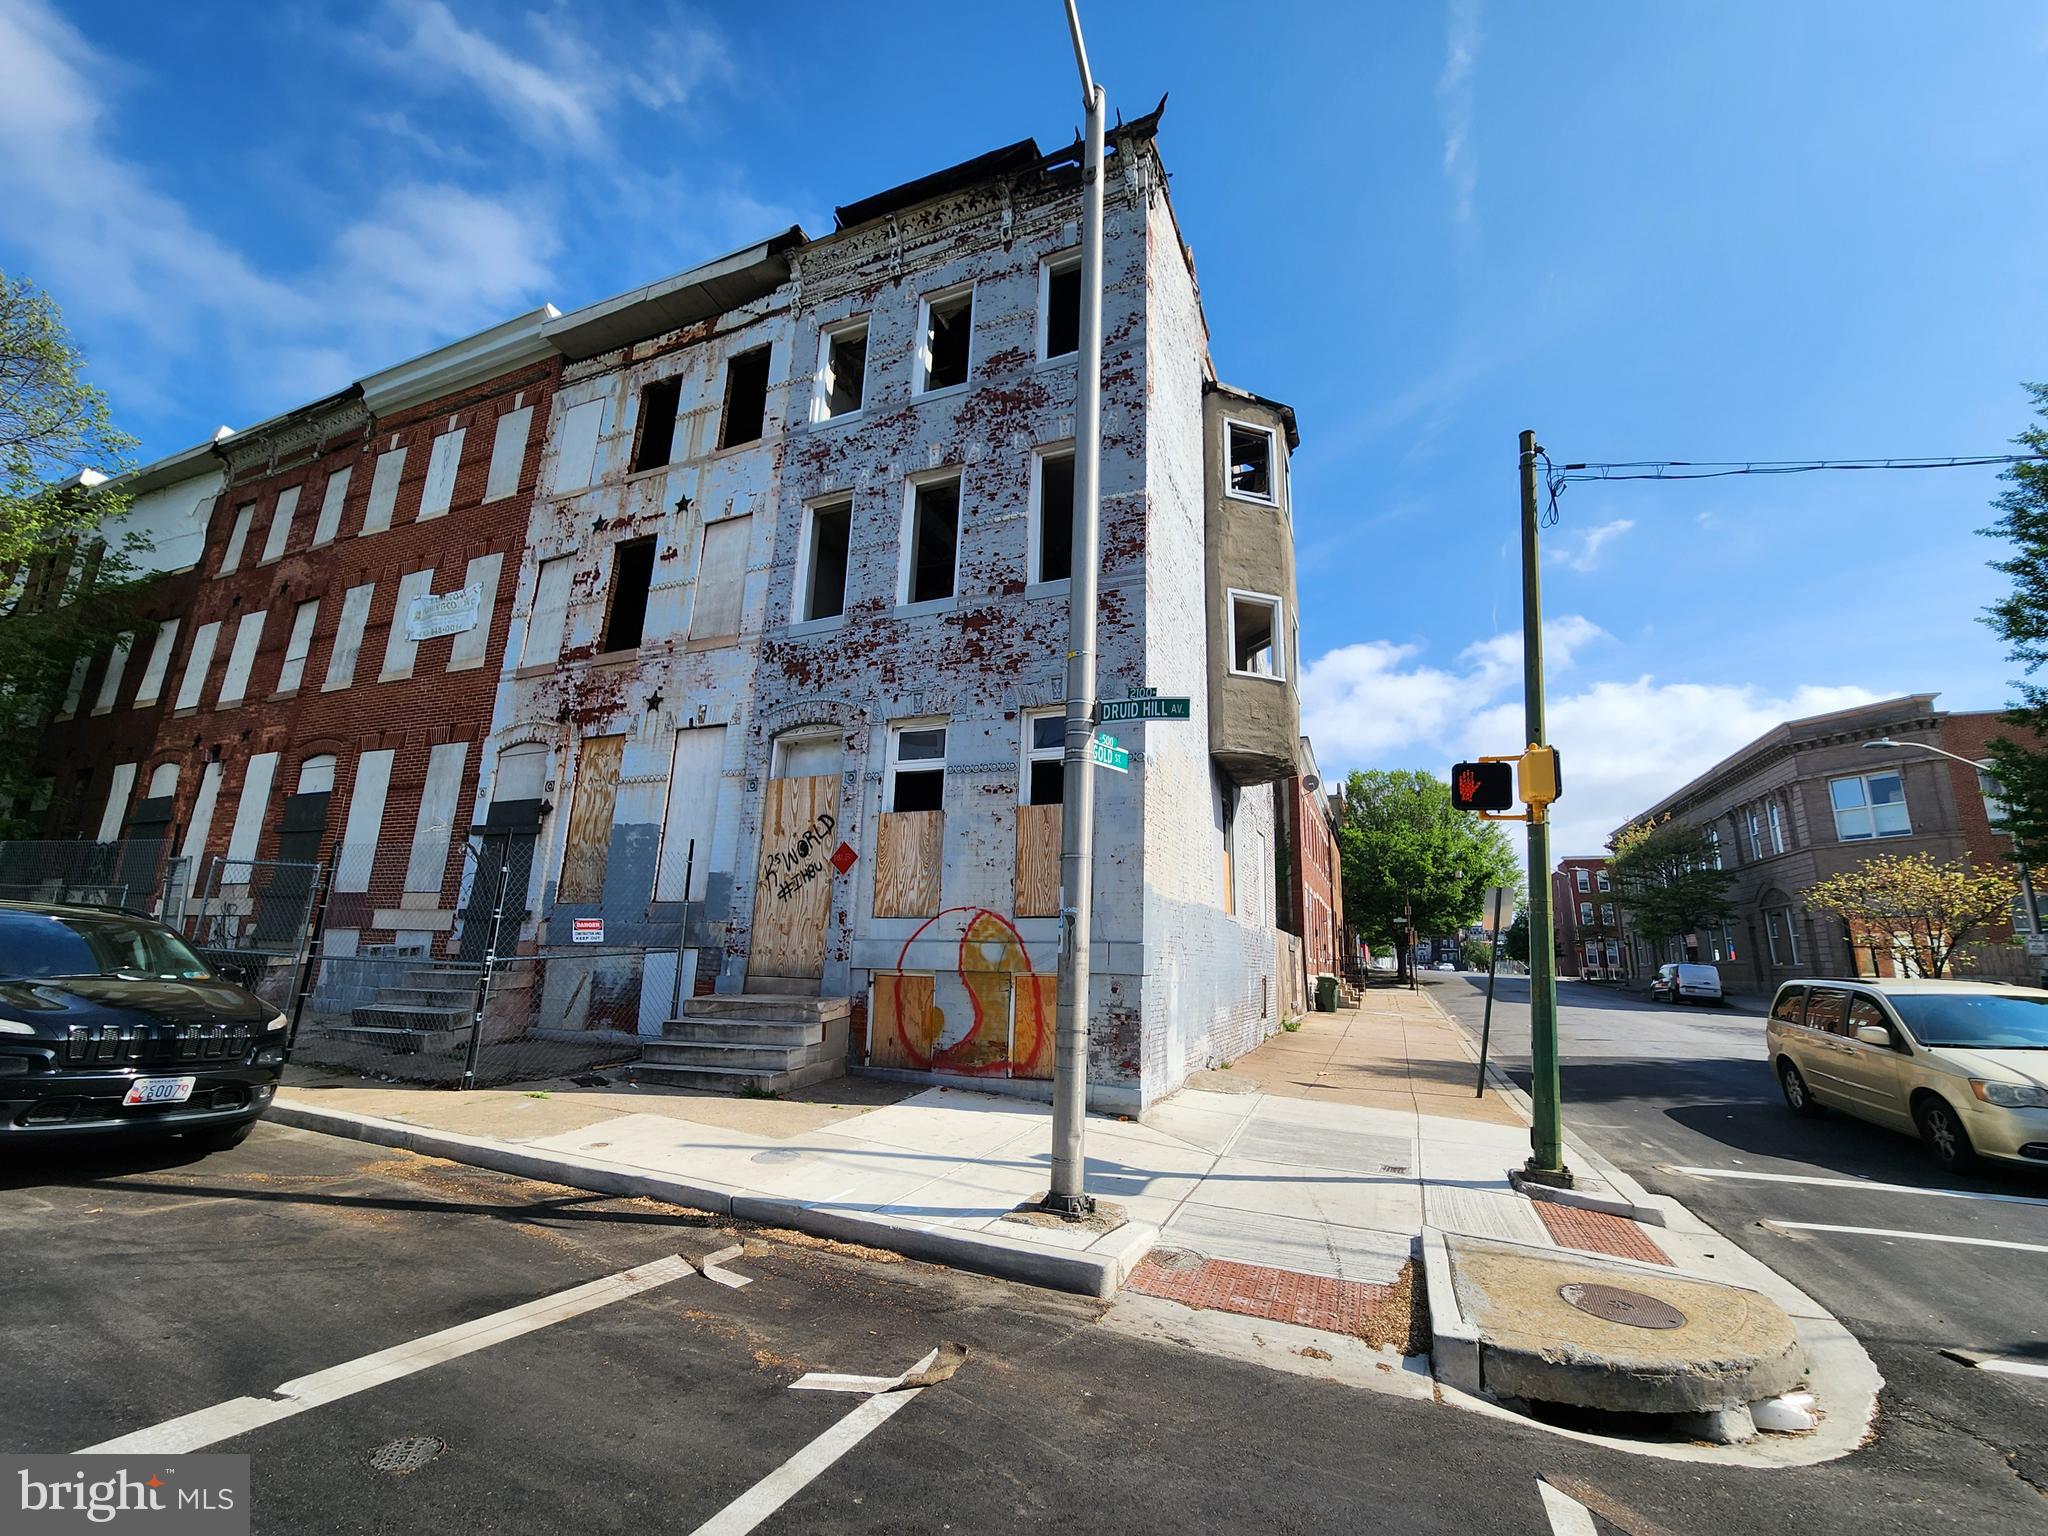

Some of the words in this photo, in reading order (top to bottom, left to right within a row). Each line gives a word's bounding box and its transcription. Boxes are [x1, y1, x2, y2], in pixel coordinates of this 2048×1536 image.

[1129, 688, 1153, 698] 2100
[1103, 702, 1139, 720] DRUID
[1143, 700, 1168, 717] HILL
[1170, 703, 1185, 714] AV.
[1102, 734, 1114, 746] 500
[1093, 745, 1113, 763] GOLD
[782, 814, 836, 872] WORLD
